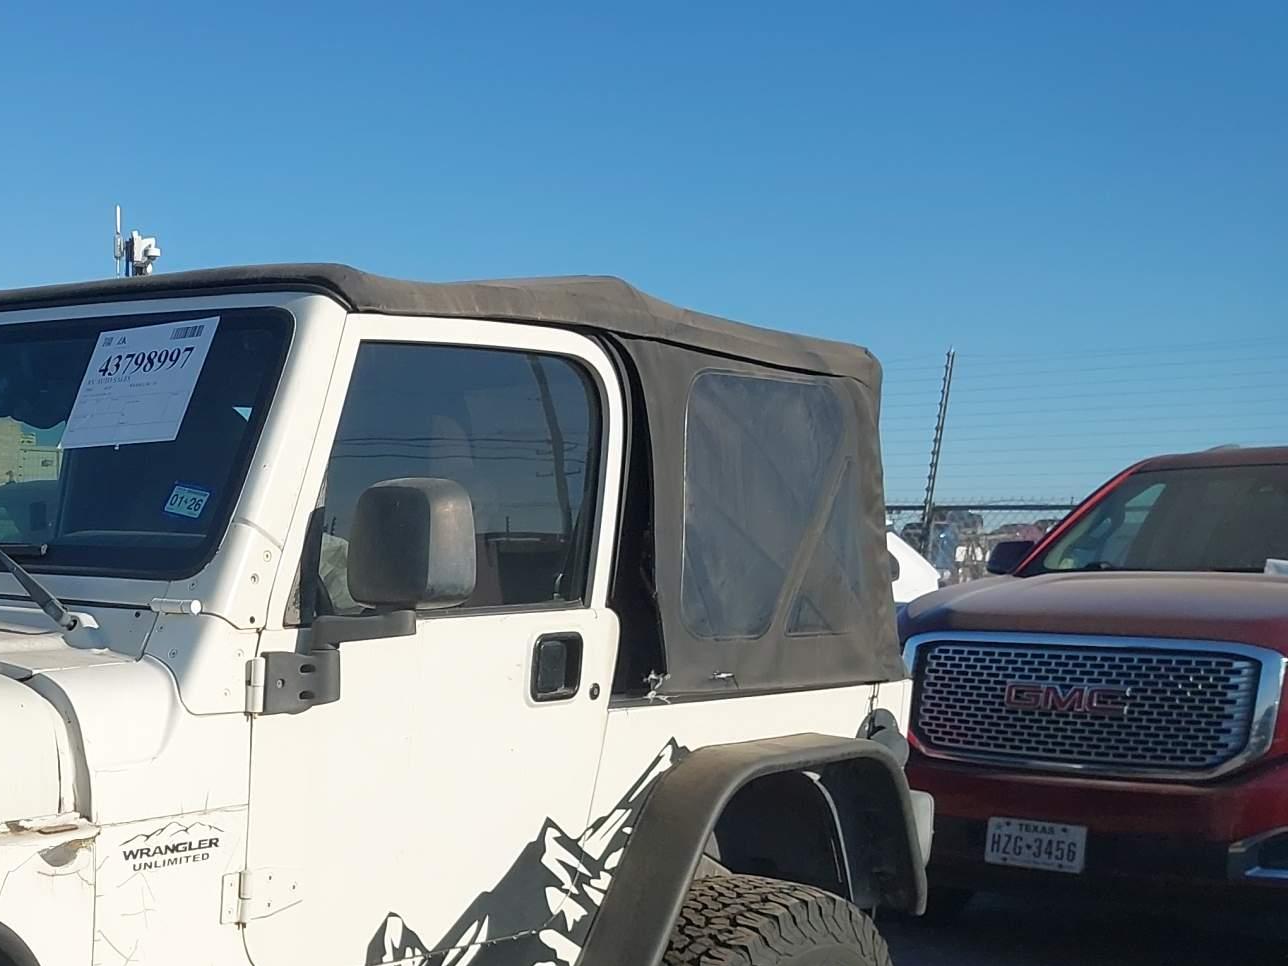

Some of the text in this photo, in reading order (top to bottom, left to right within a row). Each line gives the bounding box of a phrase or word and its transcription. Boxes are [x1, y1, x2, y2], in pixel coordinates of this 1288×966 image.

[98, 346, 195, 377] 43798997
[1005, 680, 1130, 717] GMC
[1018, 823, 1055, 835] TEXAS
[123, 837, 220, 861] WRANGLER
[132, 852, 210, 872] UNLIMITED
